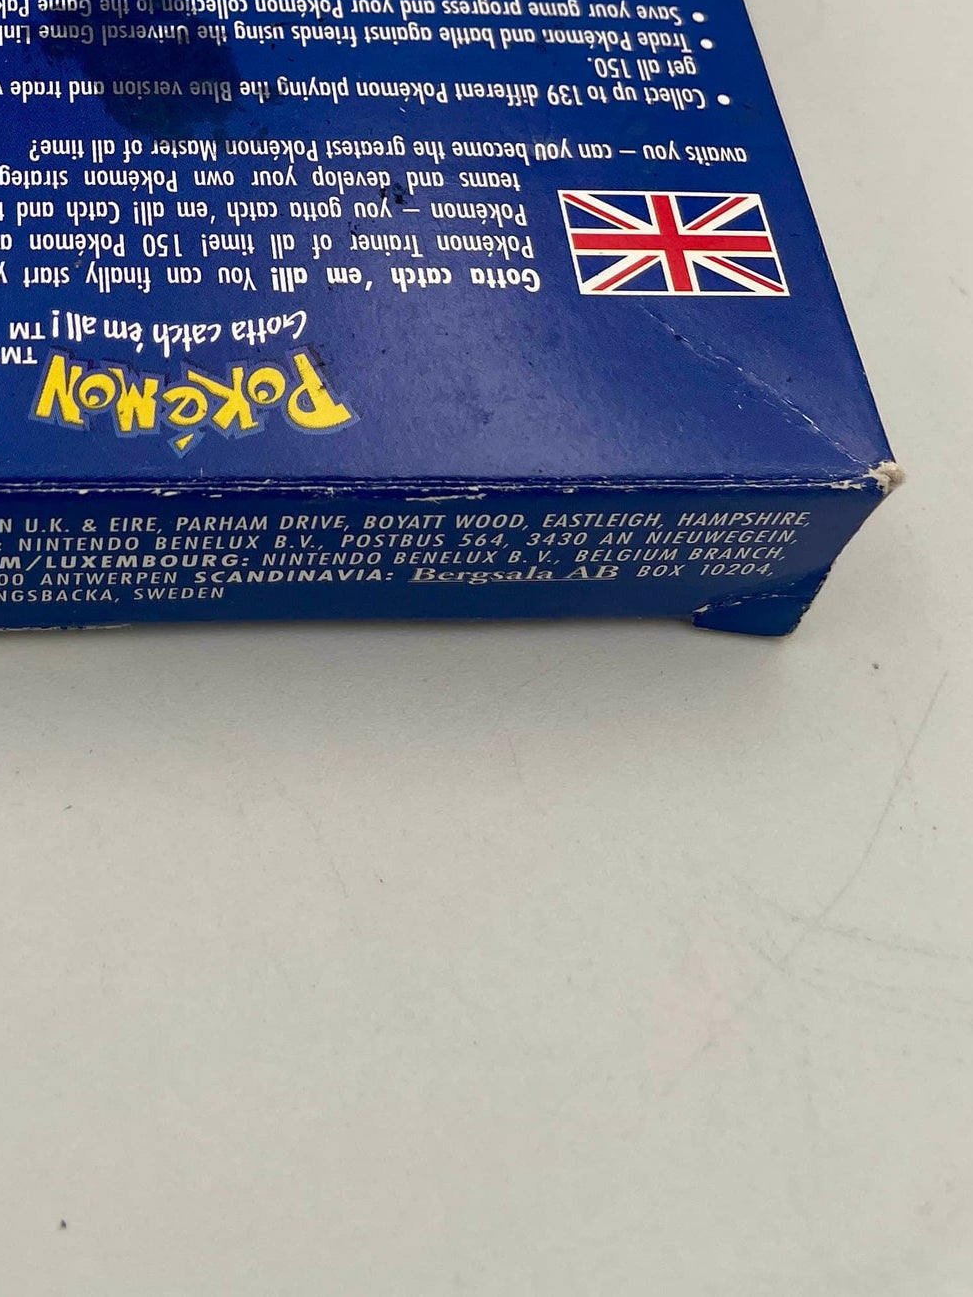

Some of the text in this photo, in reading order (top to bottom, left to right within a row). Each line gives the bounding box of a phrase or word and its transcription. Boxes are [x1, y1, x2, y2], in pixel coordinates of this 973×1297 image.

[83, 169, 178, 194] Pokémon
[193, 170, 235, 186] own
[250, 164, 298, 186] your
[311, 165, 391, 195] develop
[405, 170, 444, 195] and
[458, 171, 521, 192] teams
[22, 266, 70, 288] start
[85, 260, 151, 294] finally
[166, 266, 202, 284] can
[217, 266, 257, 291] You
[269, 266, 308, 293] all!
[389, 266, 452, 293] catch
[469, 267, 541, 293] Gotta
[153, 315, 221, 357] catch
[232, 310, 307, 346] Gotta
[24, 517, 69, 533] U.K.
[81, 518, 96, 532] &
[109, 516, 162, 534] EIRE,
[175, 515, 267, 531] PARHAM
[279, 514, 349, 531] DRIVE,
[362, 514, 446, 529] BOYATT
[455, 513, 528, 530] WOOD,
[541, 512, 663, 529] EASTLEIGH,
[676, 511, 811, 527] HAMPSHIRE,
[18, 536, 139, 551] NINTENDO
[154, 534, 259, 550] BENELUX
[340, 533, 445, 548] POSTBUS
[457, 532, 509, 548] 564,
[525, 531, 587, 546] 3430
[598, 531, 633, 545] AN
[644, 529, 797, 544] NIEUWEGEIN,
[261, 551, 381, 566] NINTENDO
[392, 550, 498, 564] BENELUX
[574, 547, 678, 562] BELGIUM
[687, 546, 785, 561] BRANCH,
[39, 571, 177, 585] ANTWERPEN
[193, 568, 393, 583] SCANDINAVIA:
[409, 565, 554, 584] Bergsala
[566, 565, 620, 580] AB
[635, 563, 685, 577] BOX
[699, 562, 773, 577] 10204,
[133, 586, 224, 600] SWEDEN
